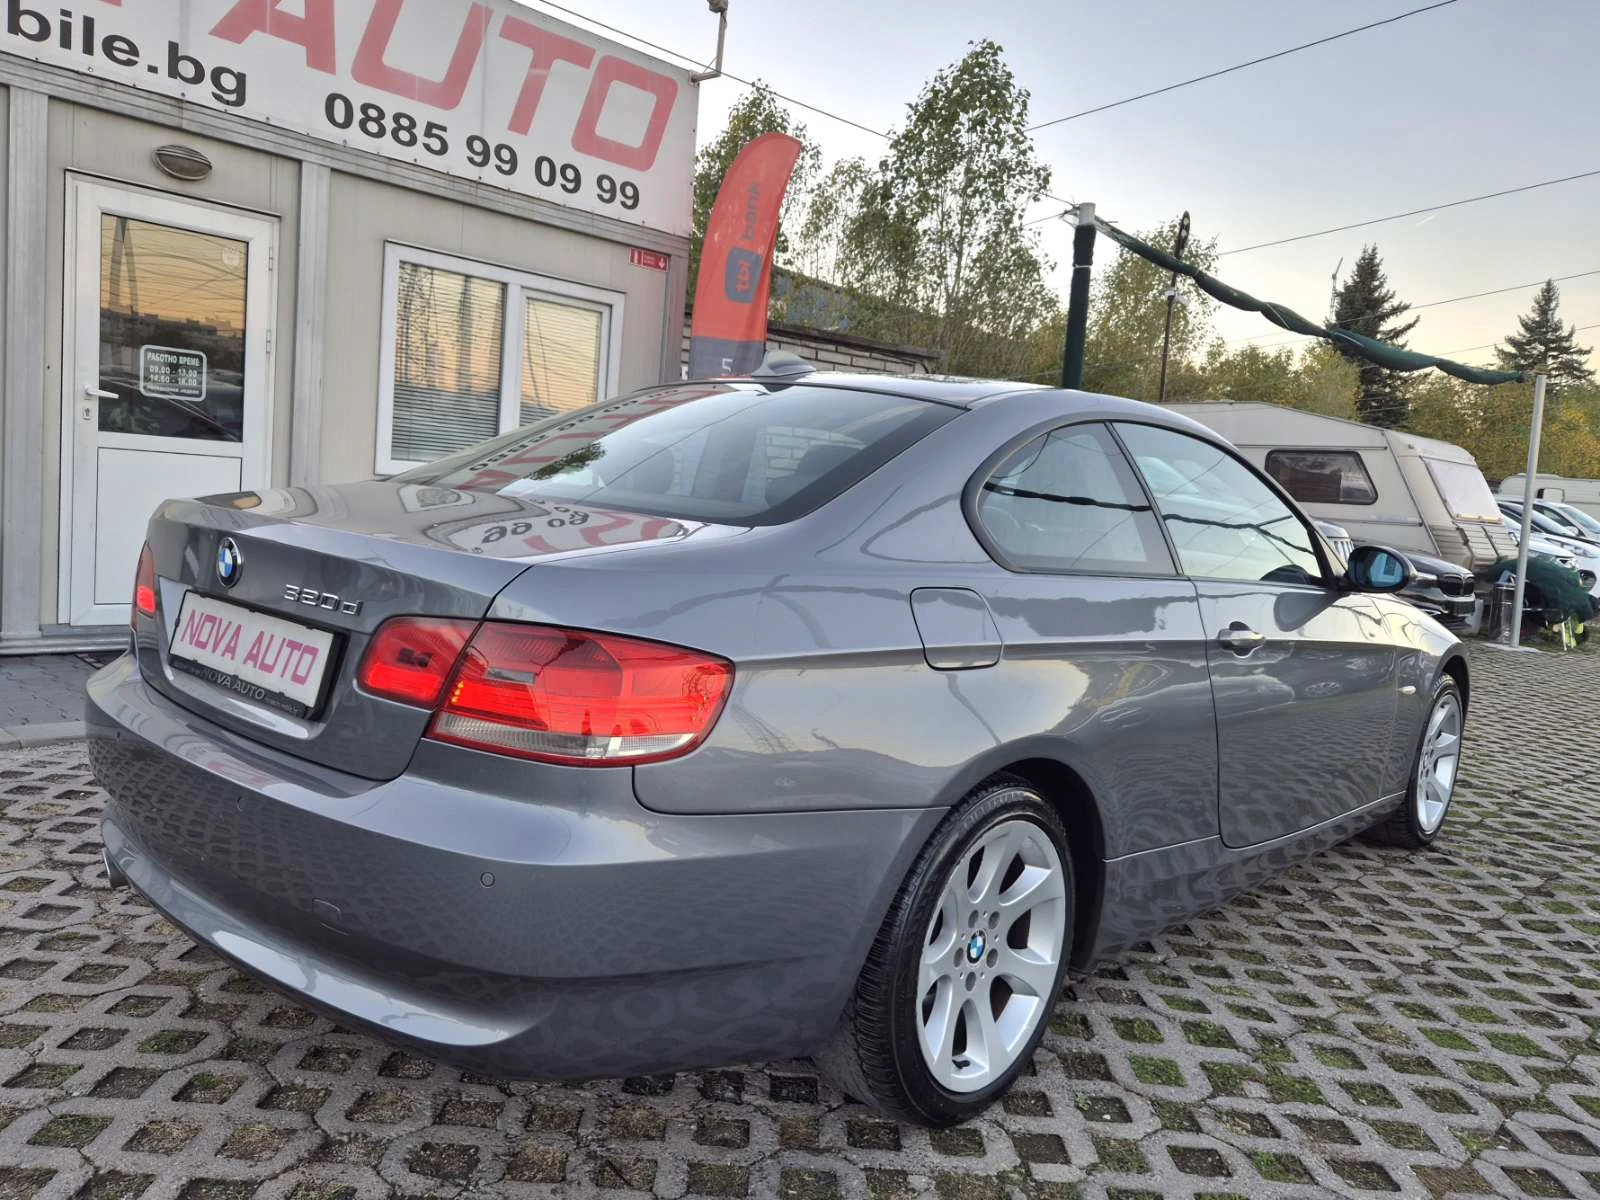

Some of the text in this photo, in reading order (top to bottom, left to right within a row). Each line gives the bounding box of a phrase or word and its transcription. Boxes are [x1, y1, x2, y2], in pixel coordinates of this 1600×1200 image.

[208, 0, 679, 172] AUTO
[324, 92, 640, 210] 0885 99 09 99
[147, 352, 200, 366] РАБОТНО ВРЕМЕ
[283, 583, 364, 617] 320d
[180, 609, 320, 685] NOVA AUTO
[232, 679, 265, 699] AUTO
